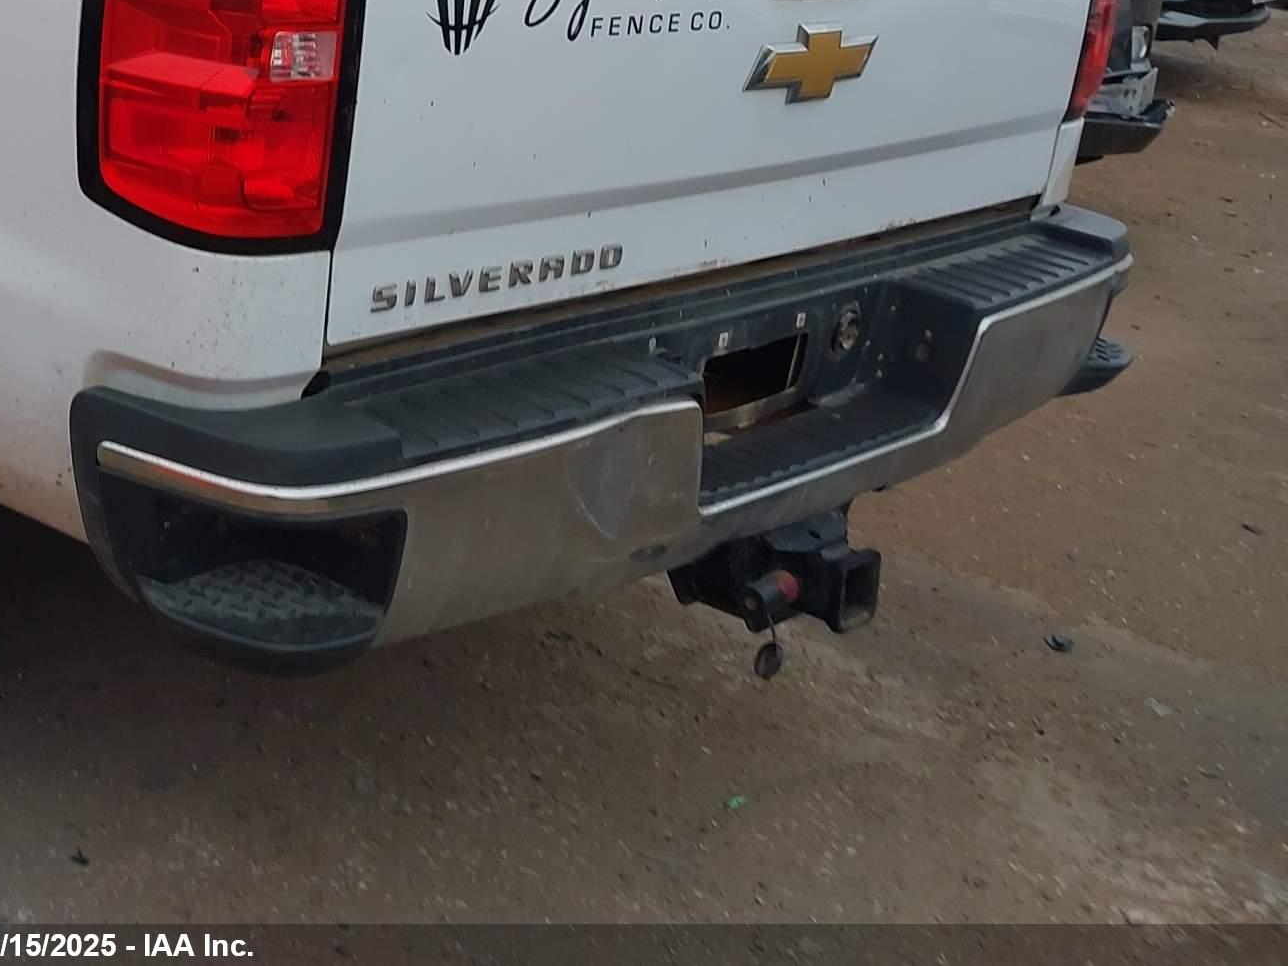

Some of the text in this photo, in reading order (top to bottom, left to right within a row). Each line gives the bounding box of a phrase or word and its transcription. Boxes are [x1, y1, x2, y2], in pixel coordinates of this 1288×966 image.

[590, 11, 731, 37] FENCE CO.
[370, 242, 624, 313] SILVERADO
